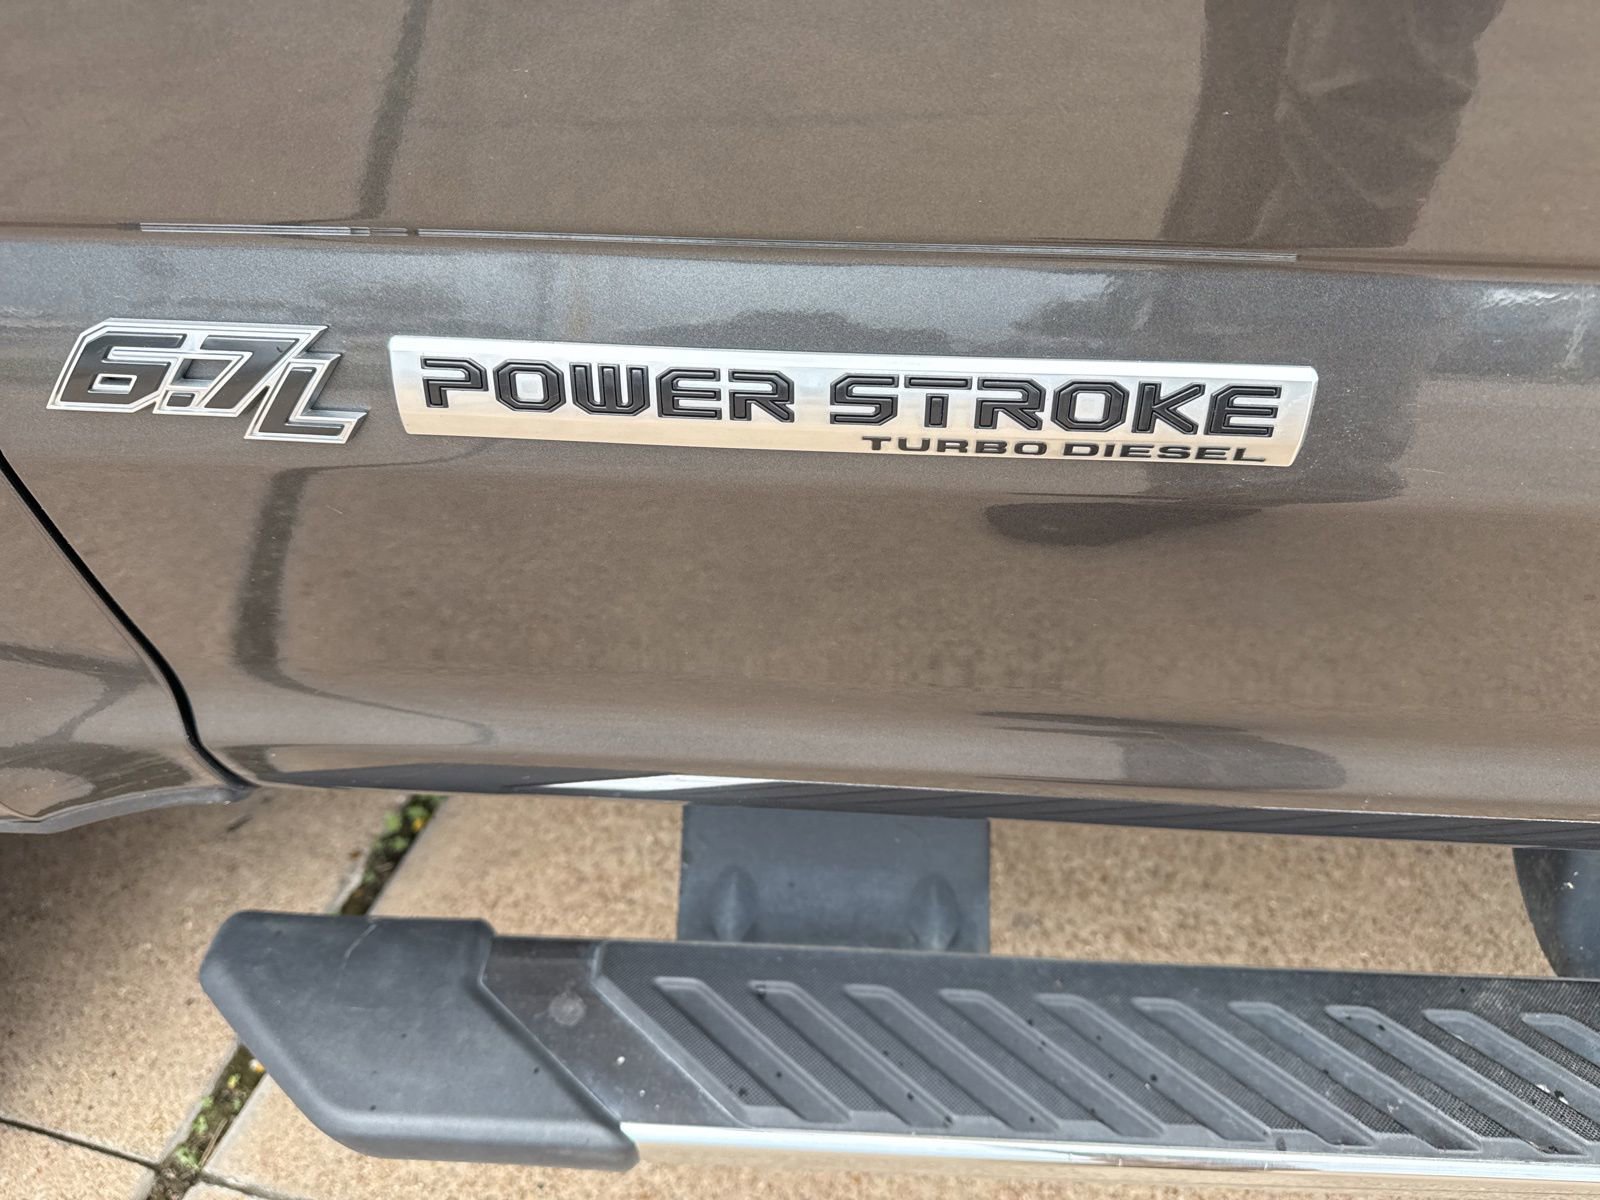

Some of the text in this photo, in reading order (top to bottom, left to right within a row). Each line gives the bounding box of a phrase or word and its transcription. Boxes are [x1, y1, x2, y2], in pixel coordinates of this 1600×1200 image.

[47, 318, 368, 444] 6.7L
[420, 355, 1283, 437] POWER STROKE
[861, 435, 1267, 463] TURBO DIESEL
